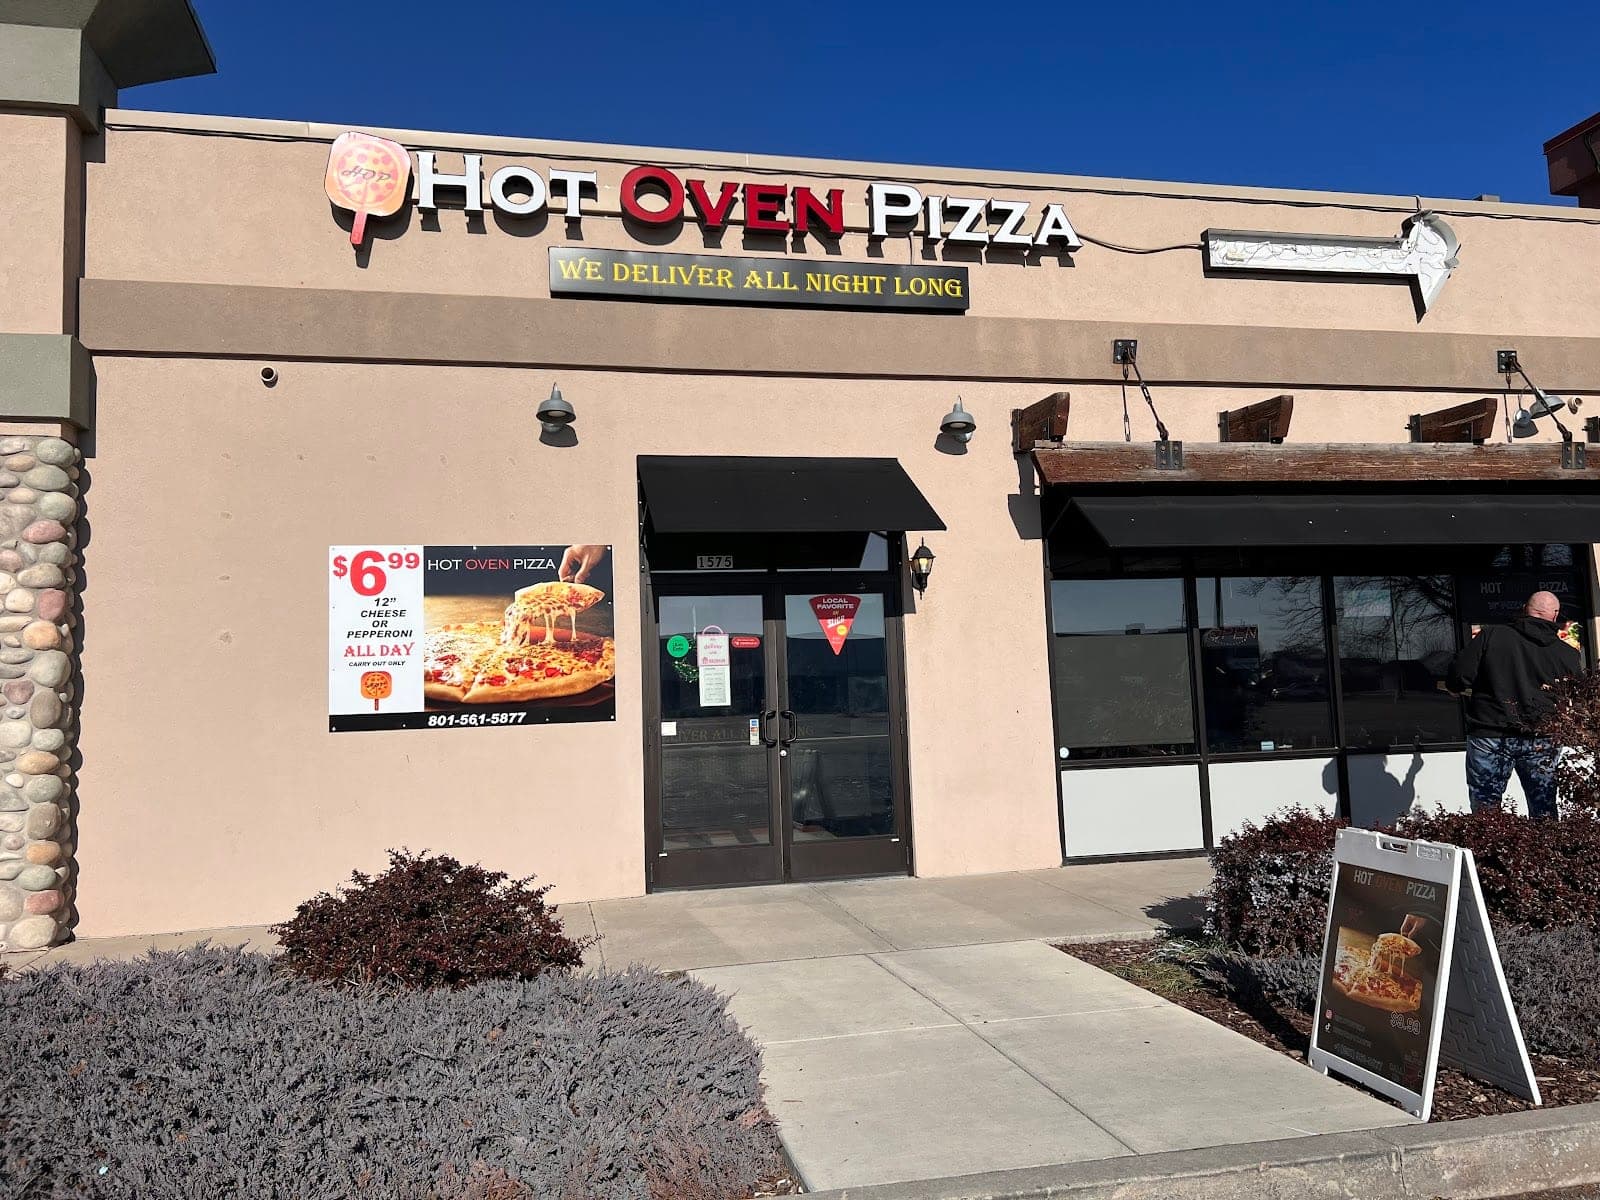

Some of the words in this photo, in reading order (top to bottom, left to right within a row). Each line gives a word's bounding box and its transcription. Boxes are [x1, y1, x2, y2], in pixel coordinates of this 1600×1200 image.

[416, 151, 598, 218] HOT
[620, 165, 845, 235] OVEN
[868, 183, 1083, 250] PIZZA
[558, 256, 604, 282] WE
[612, 262, 735, 289] DELIVER
[744, 270, 798, 291] ALL
[804, 272, 885, 295] NIGHT
[893, 276, 962, 297] LONG
[427, 559, 463, 571] HOT
[465, 558, 509, 570] OVEN
[512, 558, 556, 570] PIZZA
[699, 556, 732, 568] 1575
[1480, 581, 1502, 594] HOT
[1538, 580, 1569, 593] PIZZA
[360, 609, 407, 618] CHEESE
[371, 620, 389, 628] OR
[346, 629, 413, 639] PEPPERONI
[343, 644, 377, 657] ALL
[380, 641, 415, 657] DAY
[427, 712, 527, 727] 801-561-5877
[1353, 869, 1375, 886] HOT
[1405, 880, 1437, 902] PIZZA
